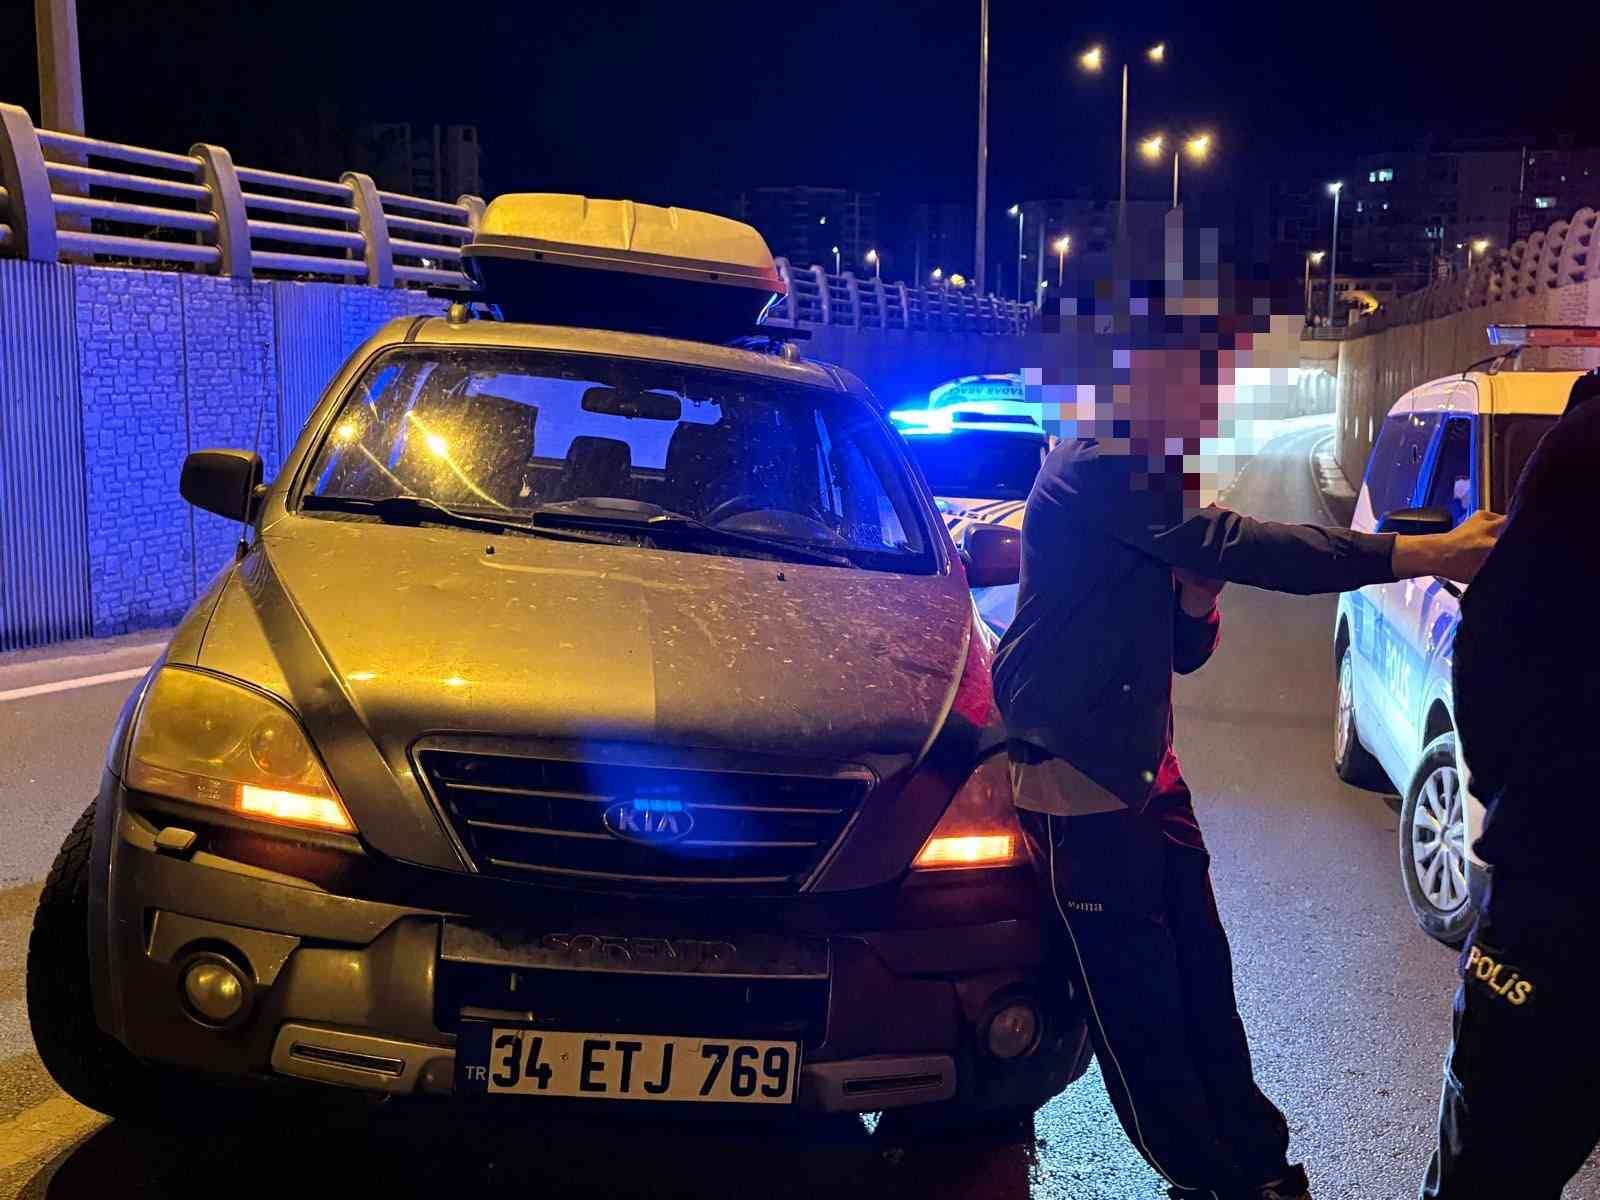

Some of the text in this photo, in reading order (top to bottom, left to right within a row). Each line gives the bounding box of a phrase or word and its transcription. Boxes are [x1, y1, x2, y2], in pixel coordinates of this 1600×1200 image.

[619, 807, 679, 833] KIA
[465, 1035, 789, 1097] TR 34 ETJ 769
